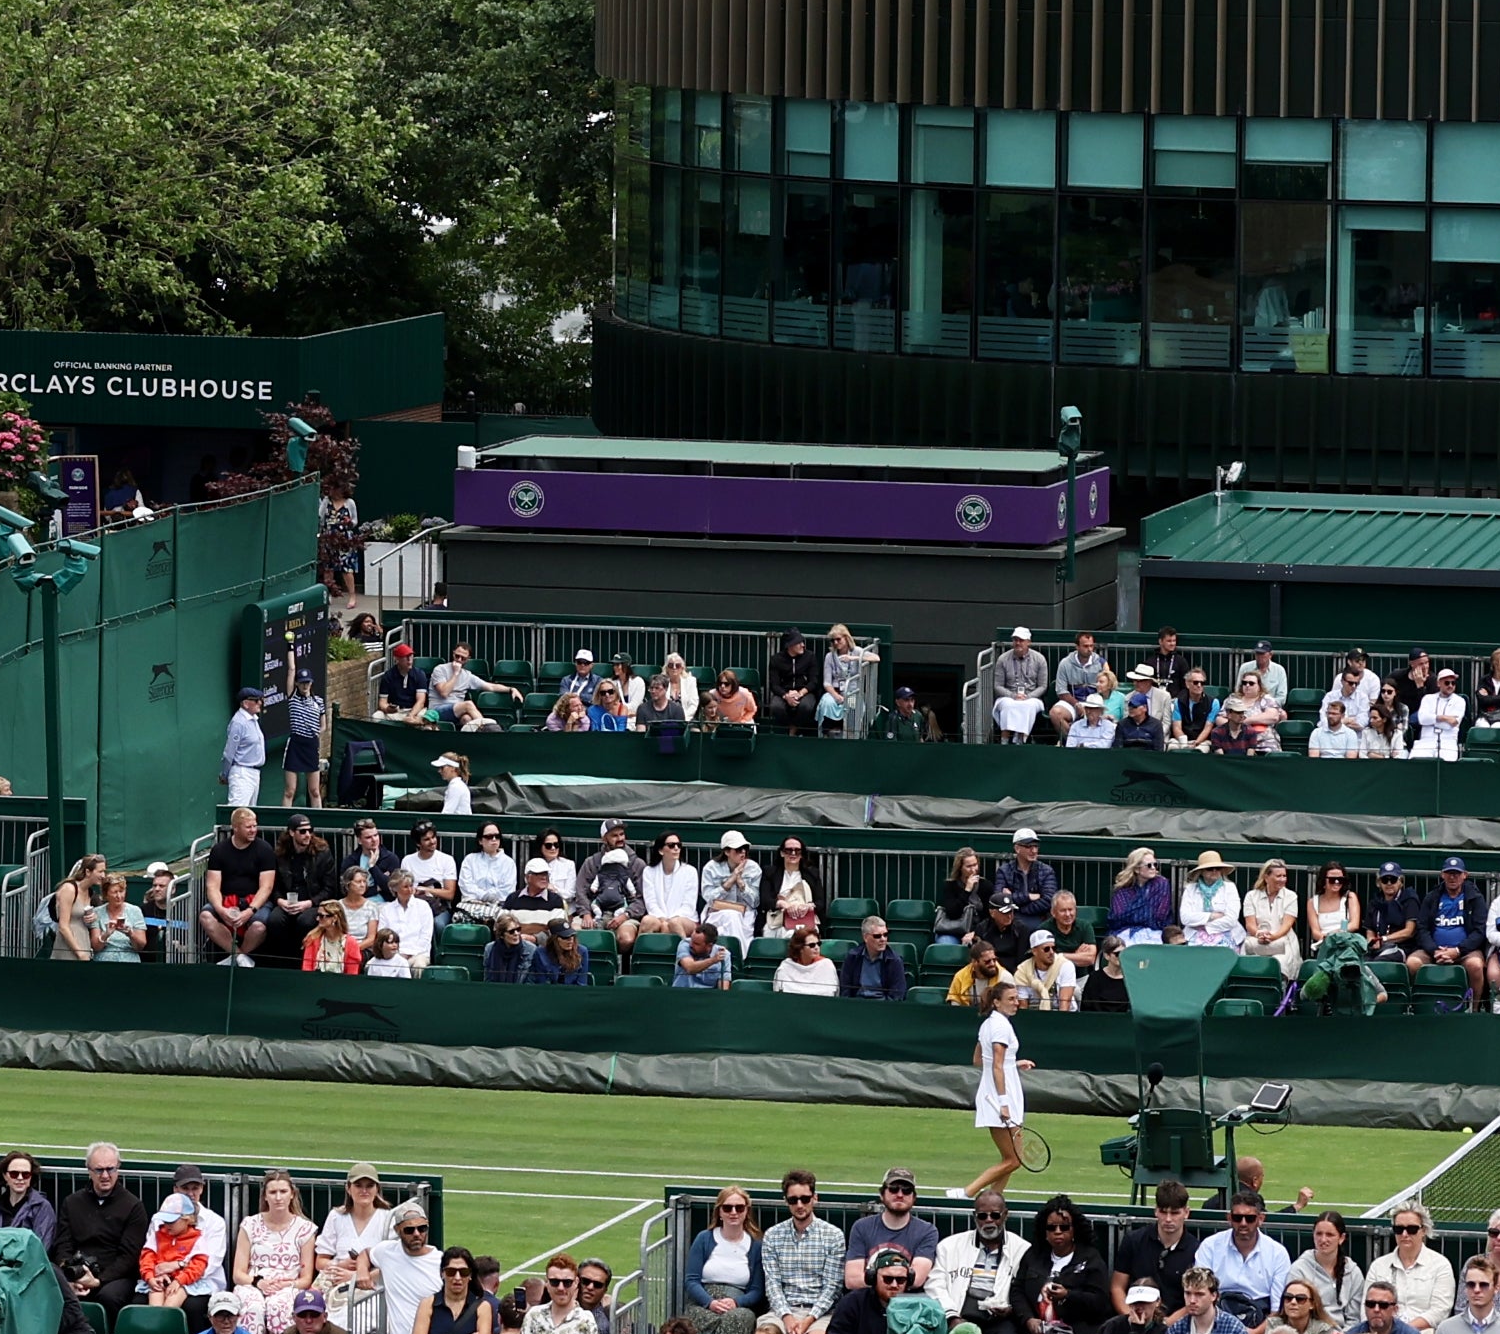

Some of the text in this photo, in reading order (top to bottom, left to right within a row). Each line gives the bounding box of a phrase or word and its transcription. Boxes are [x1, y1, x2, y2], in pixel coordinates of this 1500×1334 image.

[53, 361, 173, 372] OFFICIAL BANKING PARTNER
[106, 376, 273, 400] CLUBHOUSE
[1110, 788, 1187, 807] Slazenger
[1435, 914, 1464, 926] cinch
[302, 1022, 400, 1043] Slazenger
